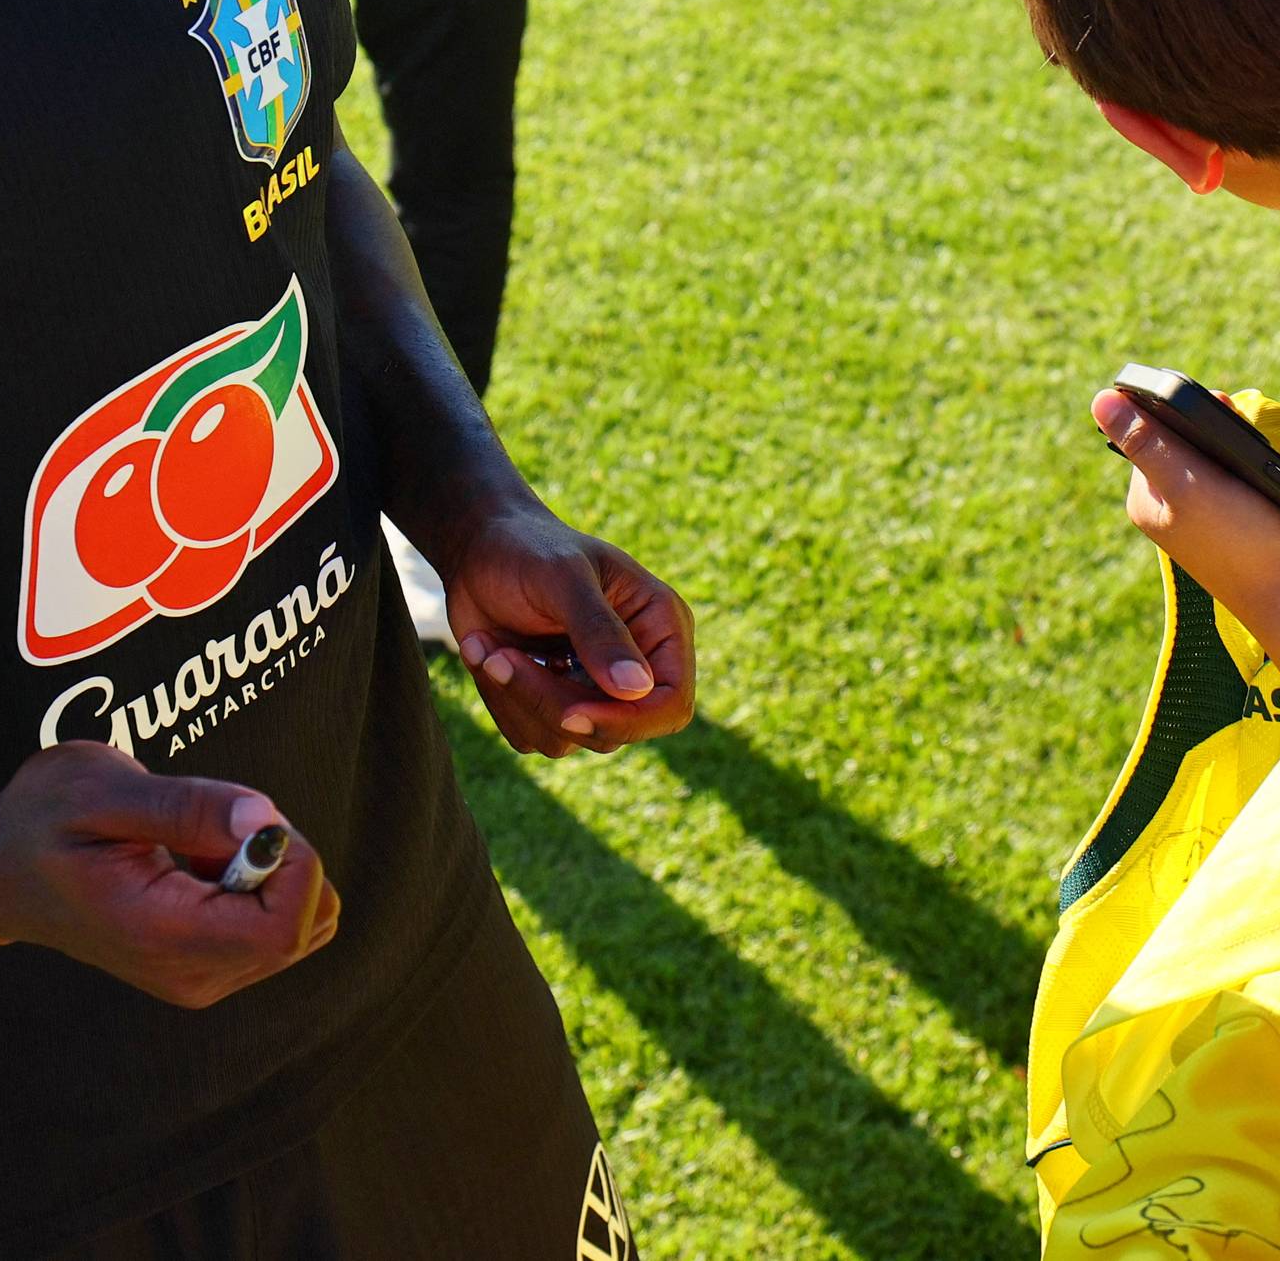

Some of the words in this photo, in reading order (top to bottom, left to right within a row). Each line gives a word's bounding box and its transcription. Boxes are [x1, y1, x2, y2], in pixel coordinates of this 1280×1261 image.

[247, 30, 281, 74] CBF
[39, 541, 356, 758] Guaraná
[169, 624, 326, 758] ANTARCTICA
